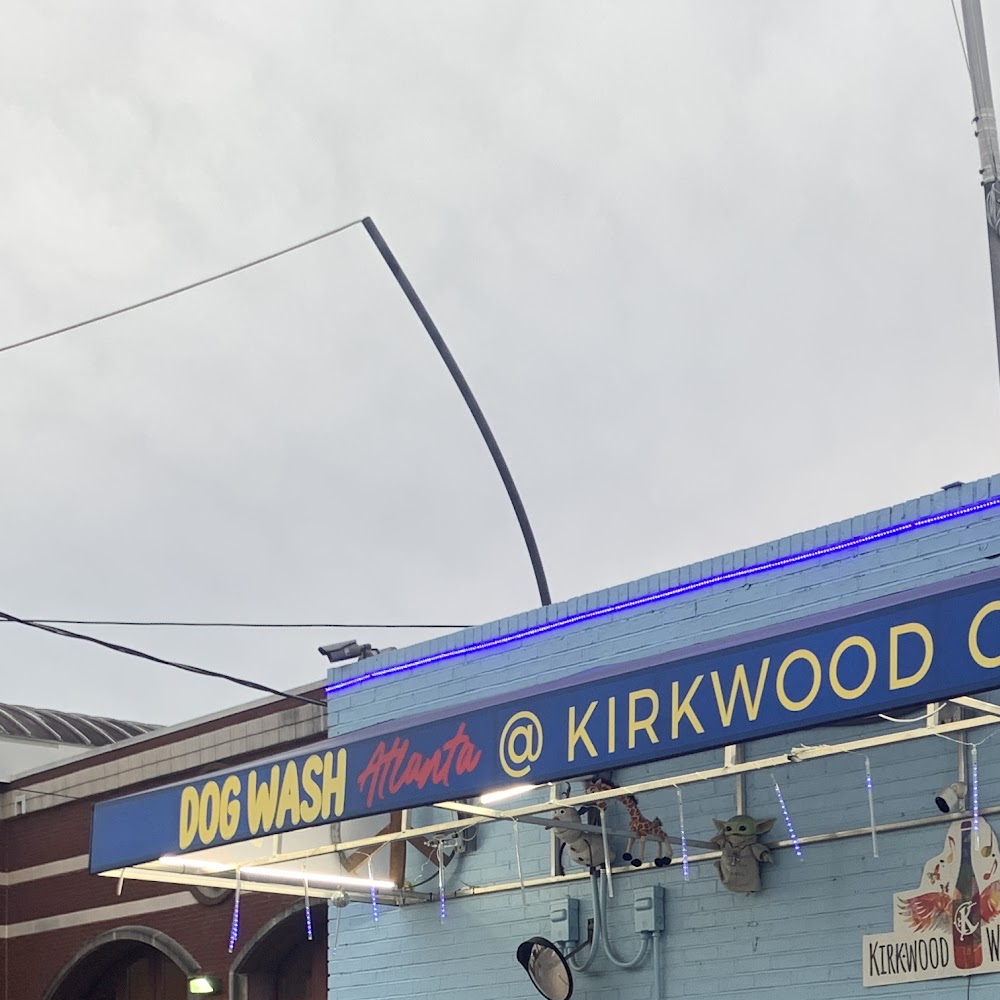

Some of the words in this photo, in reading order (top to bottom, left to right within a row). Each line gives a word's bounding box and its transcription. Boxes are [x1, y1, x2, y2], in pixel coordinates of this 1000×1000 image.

[178, 779, 240, 850] DOG
[247, 748, 347, 836] WASH
[357, 722, 483, 808] Atlanta
[499, 711, 544, 777] @
[567, 623, 934, 762] KIRKWOOD
